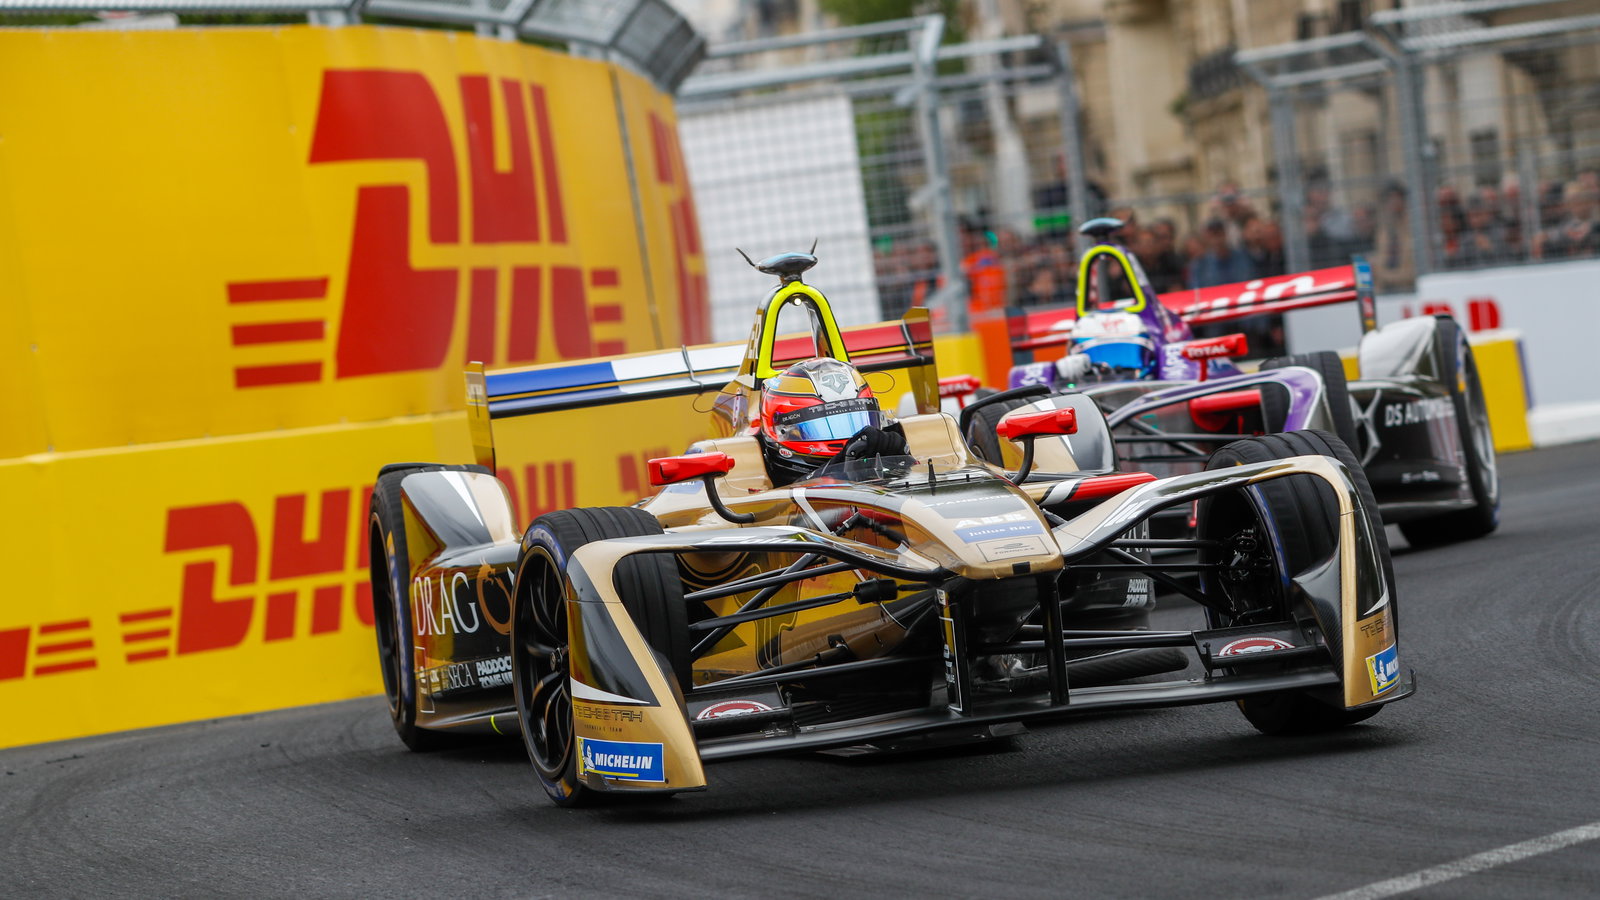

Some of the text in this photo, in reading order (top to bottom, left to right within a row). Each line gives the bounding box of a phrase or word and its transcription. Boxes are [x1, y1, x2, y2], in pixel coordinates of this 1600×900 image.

[308, 68, 592, 380] DHL
[1187, 344, 1229, 357] TOTAL
[1384, 404, 1403, 426] DS
[780, 448, 792, 456] BELL
[968, 527, 1007, 538] Julius
[414, 563, 516, 636] DRAGO
[475, 655, 512, 677] PADDOC
[594, 752, 653, 769] MICHELIN
